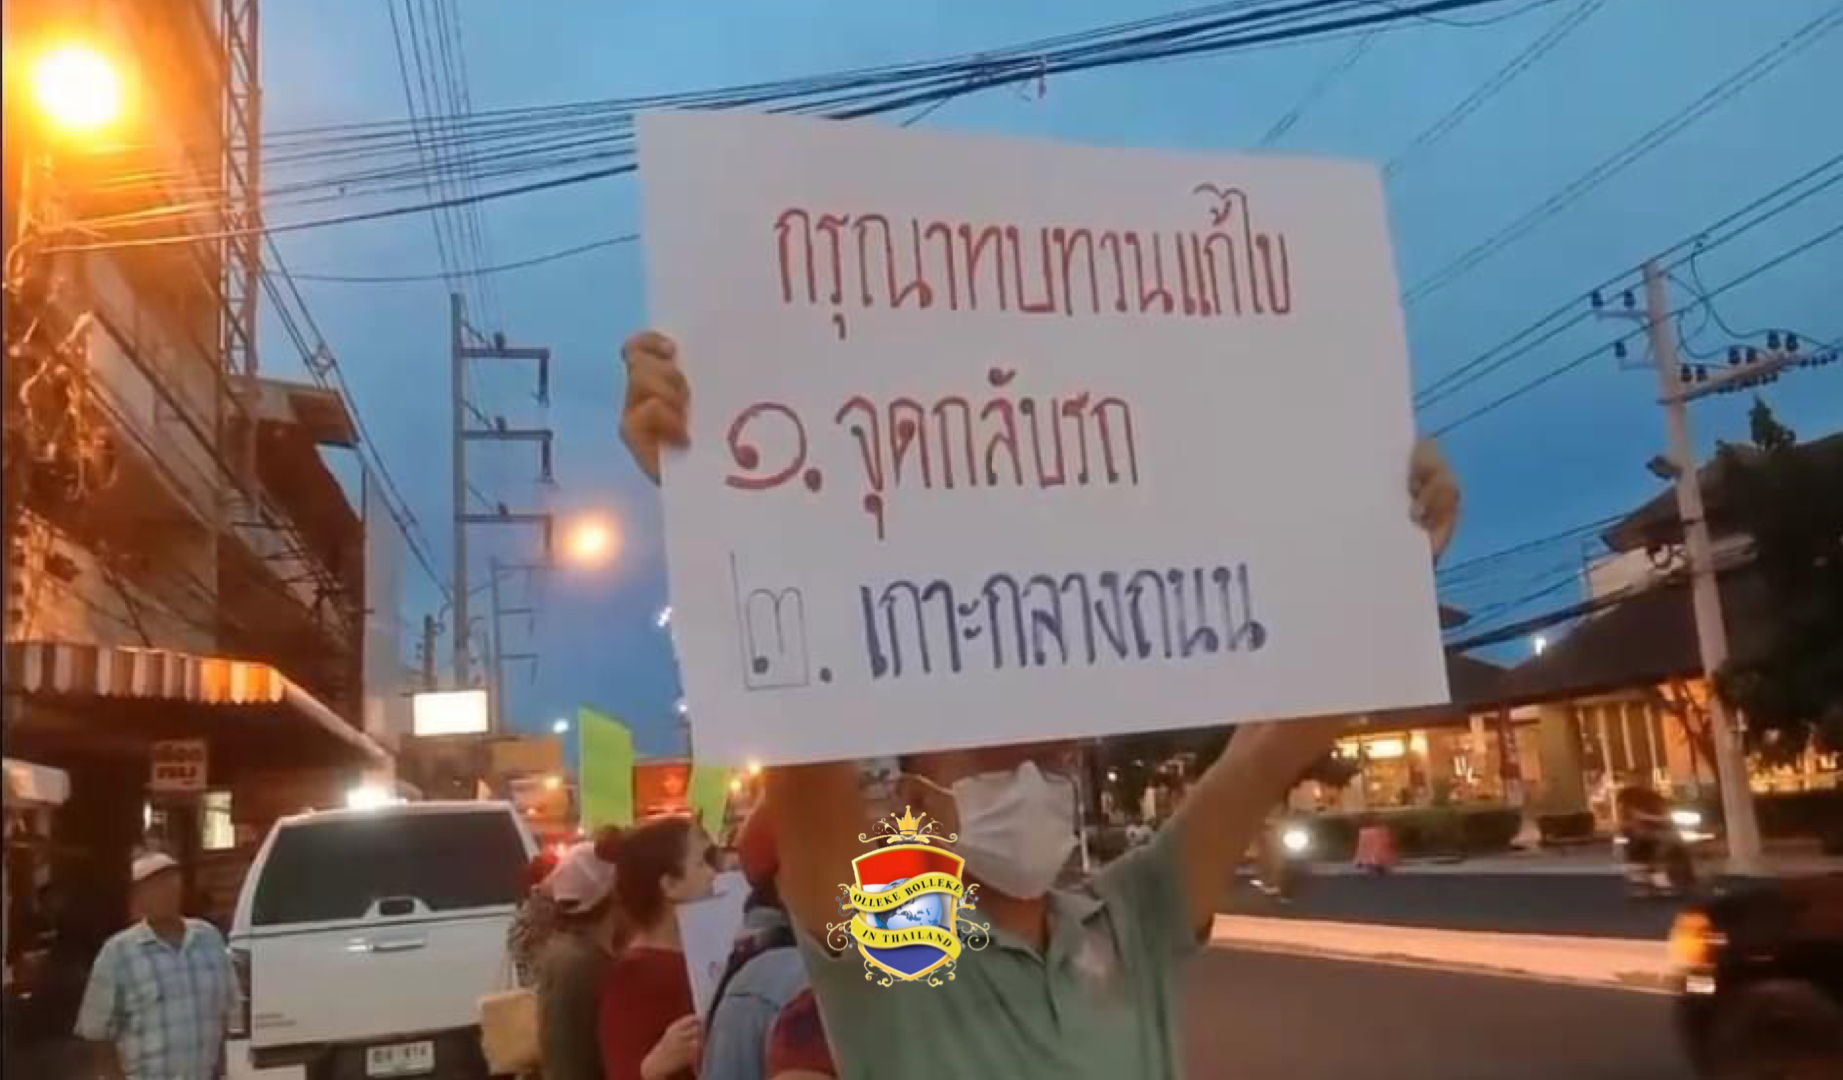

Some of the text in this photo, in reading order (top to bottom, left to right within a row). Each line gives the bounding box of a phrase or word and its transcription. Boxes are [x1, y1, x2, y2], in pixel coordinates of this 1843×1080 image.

[774, 183, 1291, 340] กรุณาทบทวนแก้ไข
[835, 367, 1138, 541] จุดกลับรถ
[860, 563, 1267, 679] เกาะกลางถนน
